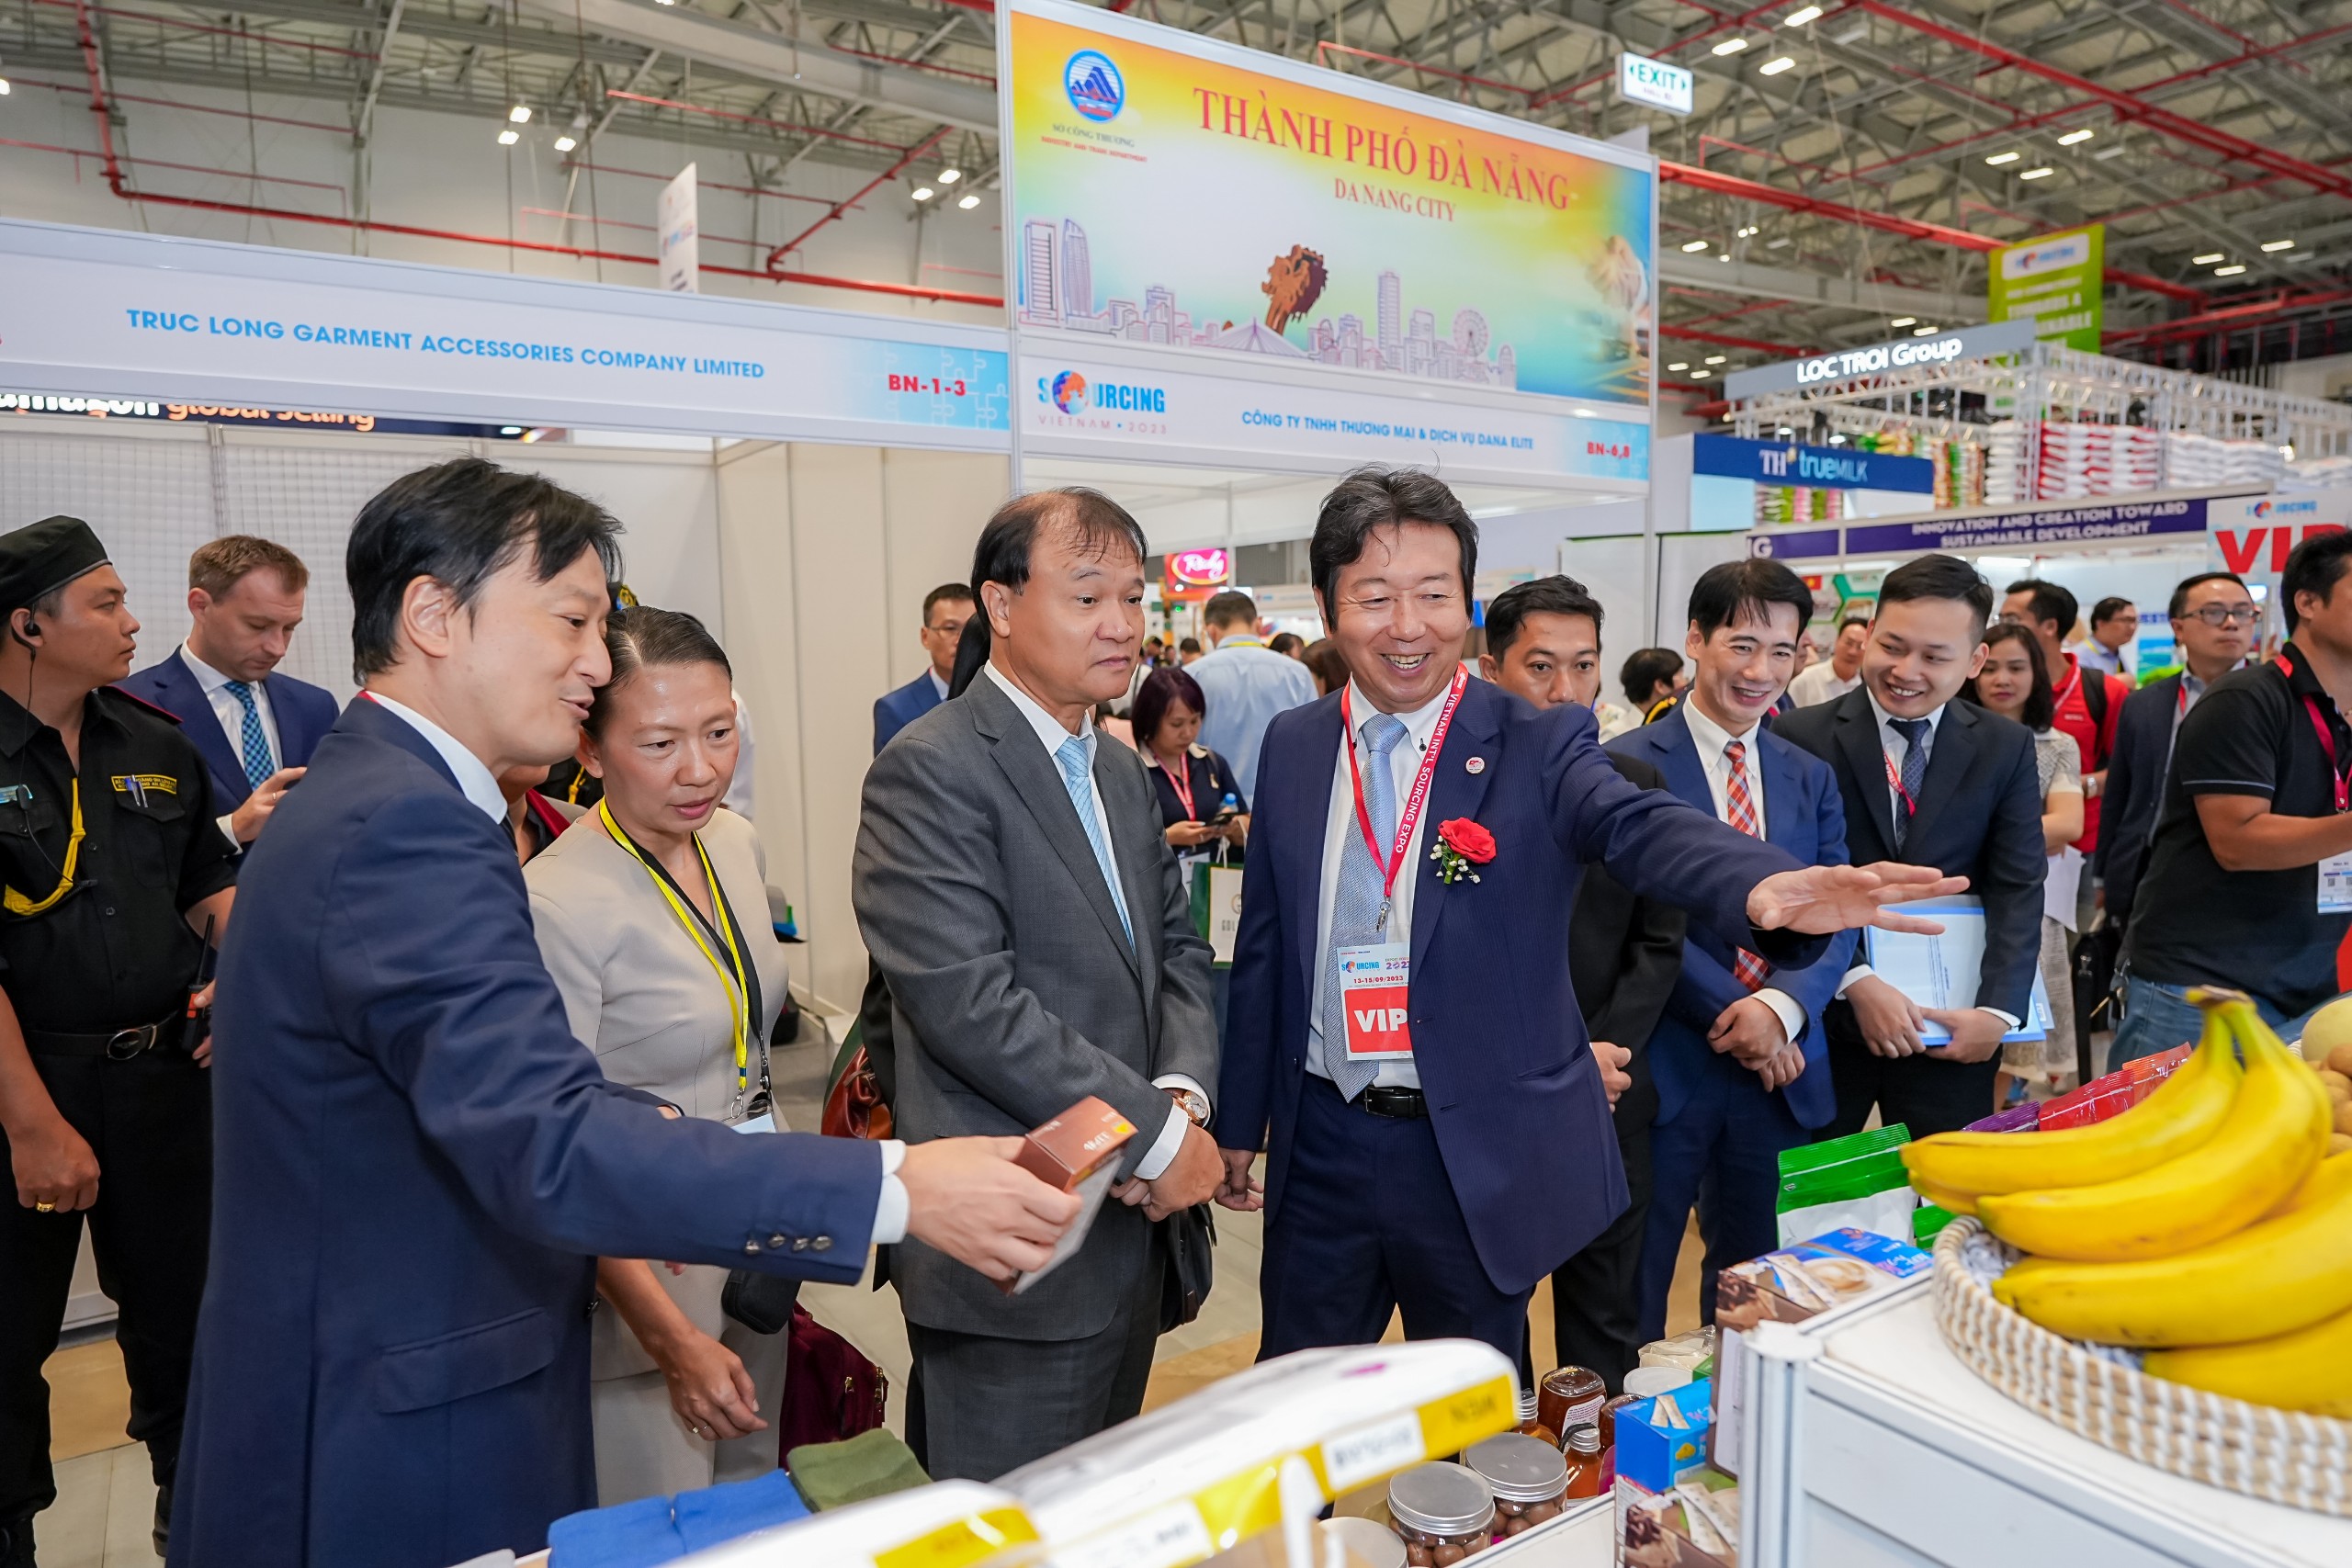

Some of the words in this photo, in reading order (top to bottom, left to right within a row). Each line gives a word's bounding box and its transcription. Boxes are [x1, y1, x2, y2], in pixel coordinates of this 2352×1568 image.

[1638, 63, 1677, 89] EXIT
[1193, 87, 1333, 157] THÀNH
[1344, 124, 1418, 175] PHỐ
[1427, 139, 1473, 189] ĐÀ
[1334, 177, 1359, 202] DA
[1363, 184, 1412, 213] NANG
[1416, 196, 1456, 221] CITY
[126, 309, 199, 333] TRUC
[209, 316, 285, 339] LONG
[293, 324, 412, 350] GARMENT
[421, 335, 574, 364] ACCESSORIES
[581, 349, 686, 372] COMPANY
[694, 358, 764, 378] LIMITED
[1797, 356, 1838, 384] LOC
[1839, 346, 1888, 376] TROI
[1891, 338, 1962, 367] Group
[888, 374, 966, 397] BN-1-3
[1038, 415, 1111, 429] VIETNAM
[1128, 422, 1167, 434] 2023
[1242, 409, 1283, 426] CÔNG
[1286, 415, 1300, 428] TY
[1305, 417, 1337, 432] TNHH
[1419, 428, 1427, 440] &
[1478, 434, 1508, 446] DANA
[1511, 436, 1533, 449] ELITE
[1588, 442, 1630, 459] BN-6,8
[1758, 449, 1787, 477] TH
[1912, 517, 1999, 536] INNOVATION
[2001, 513, 2032, 528] AND
[2035, 507, 2113, 526] CREATION
[2116, 501, 2188, 520] TOWARD
[1940, 529, 2033, 548] SUSTAINABLE
[2037, 520, 2151, 542] DEVELOPMENT
[1433, 694, 1459, 736] VIETNAM
[1424, 739, 1441, 764] INT'L
[1406, 767, 1430, 821] SOURCING
[1396, 824, 1411, 853] EXPO
[1354, 976, 1404, 984] 13-15/09/2023
[1353, 1008, 1408, 1032] VIP
